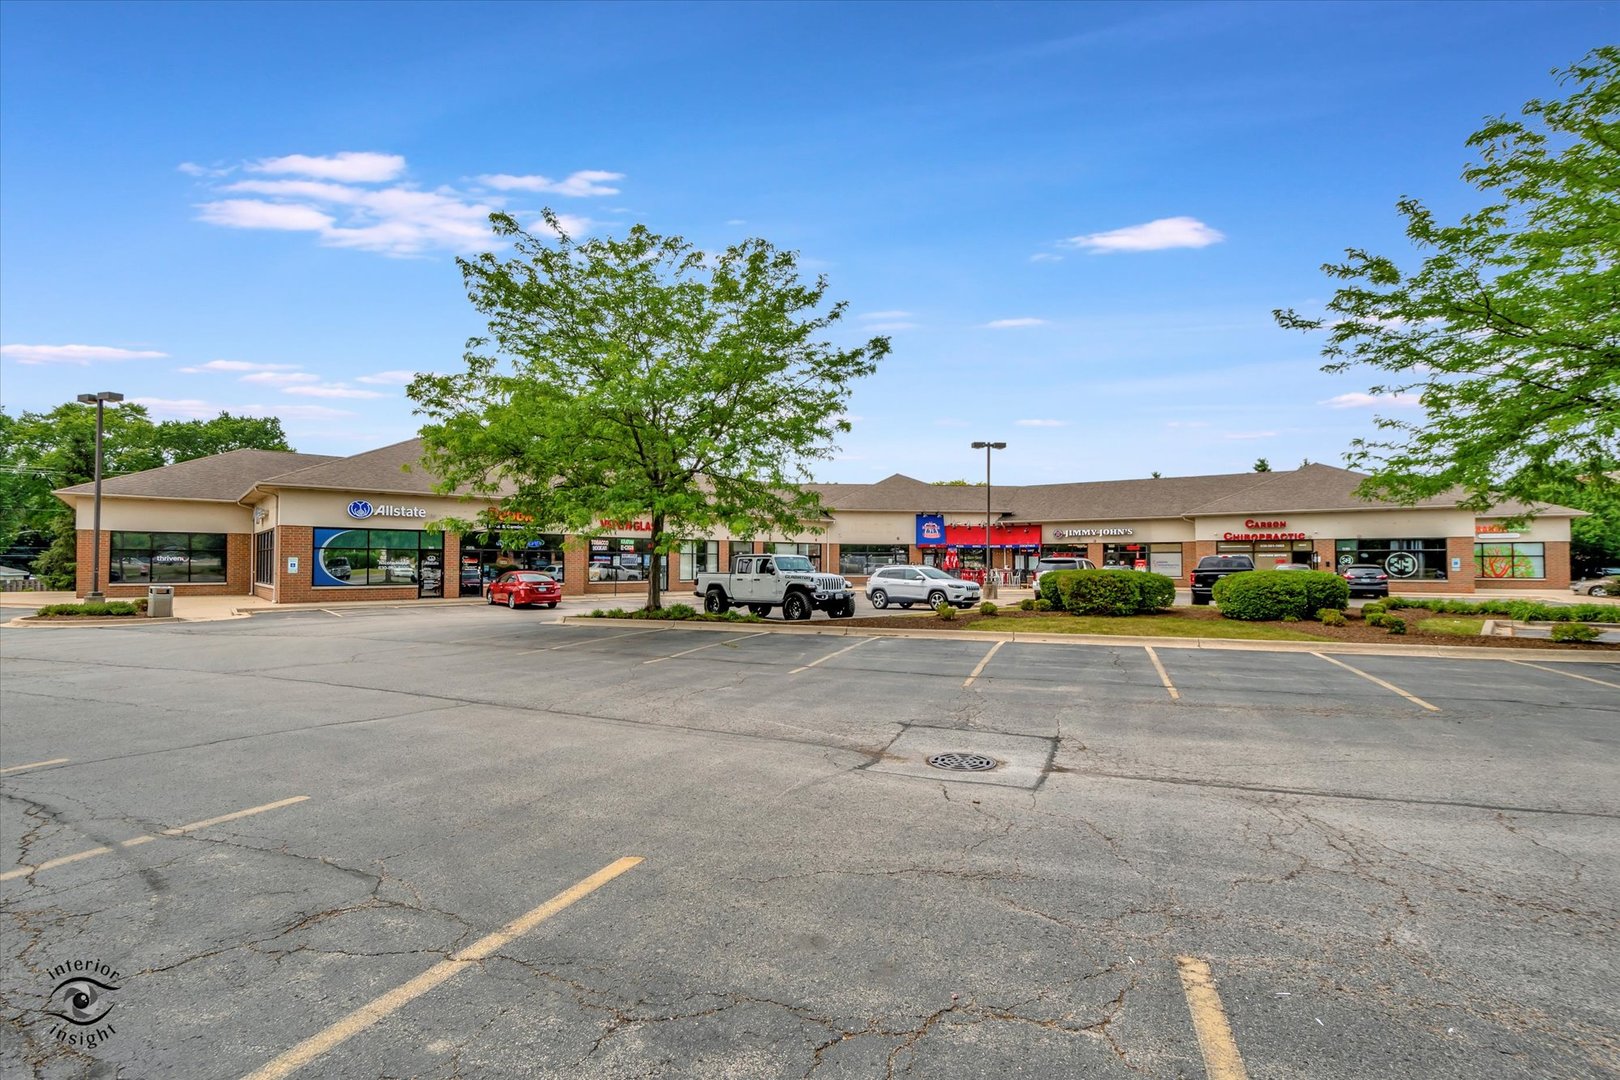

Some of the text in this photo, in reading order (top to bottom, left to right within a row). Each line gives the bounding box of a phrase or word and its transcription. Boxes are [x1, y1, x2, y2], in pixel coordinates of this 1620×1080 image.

[373, 504, 427, 518] Allstate
[1064, 528, 1133, 538] JIMMY JOHN'S
[1223, 532, 1306, 541] CHIROPRACTIC
